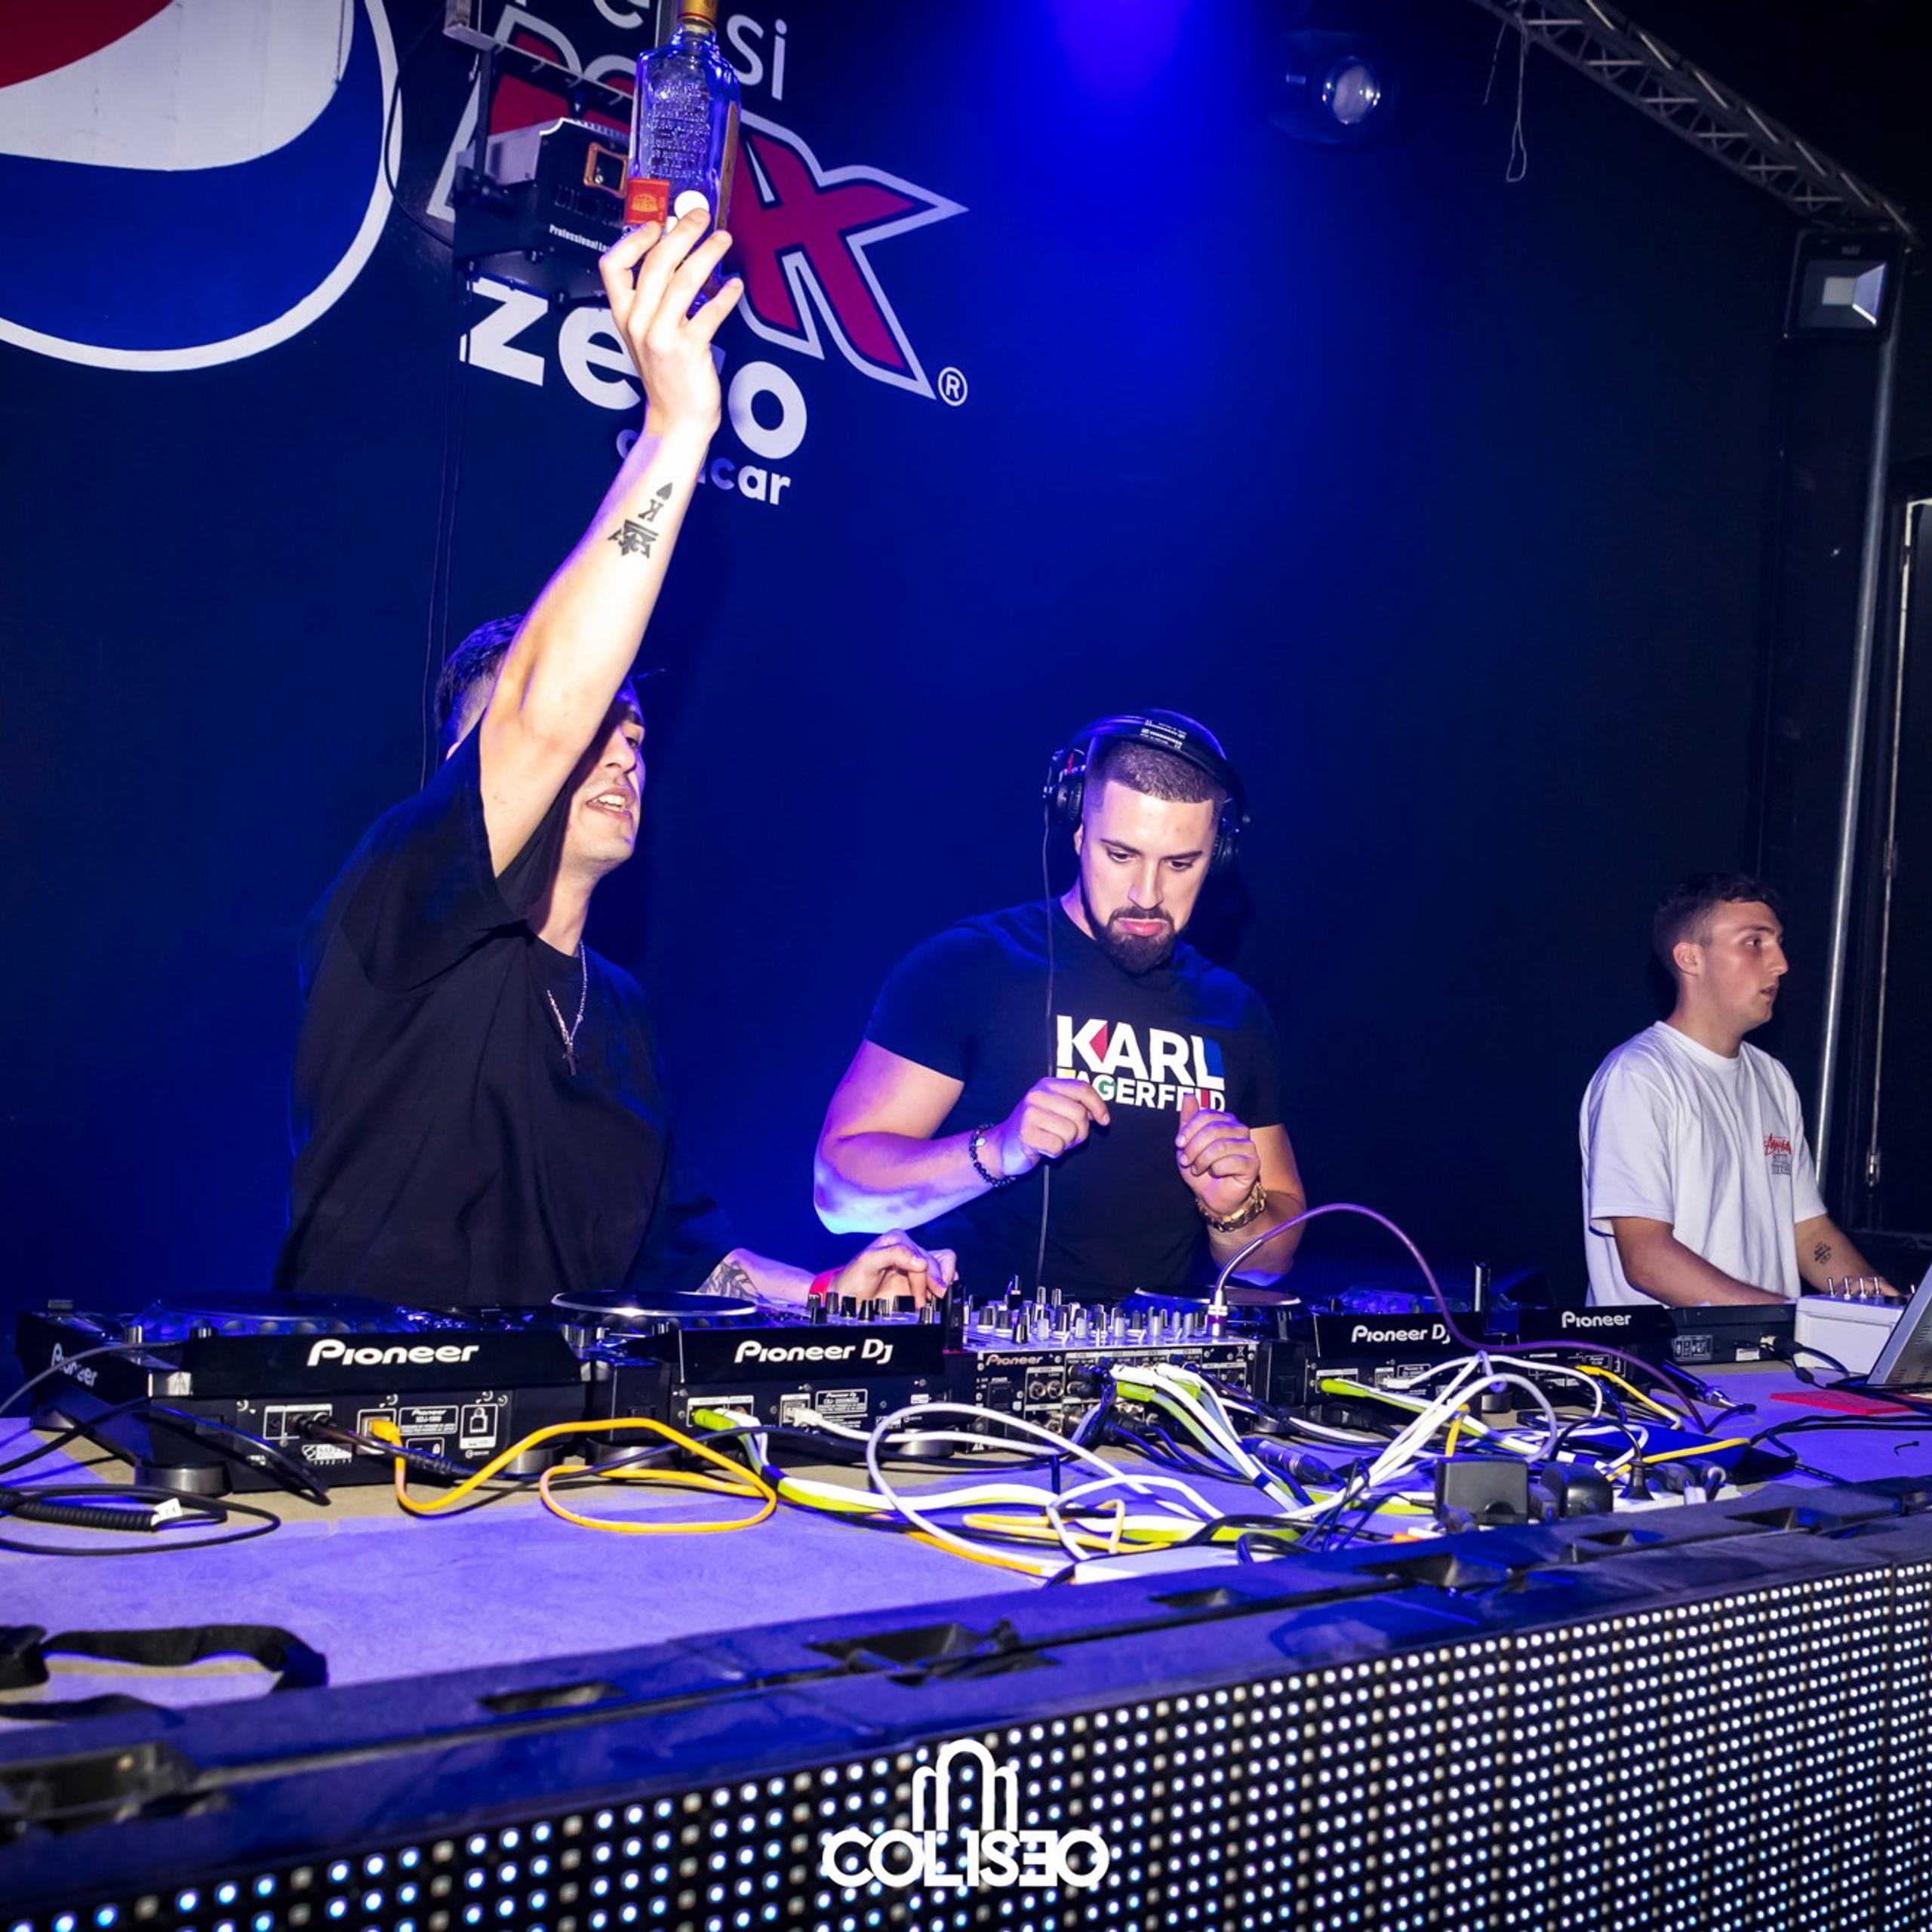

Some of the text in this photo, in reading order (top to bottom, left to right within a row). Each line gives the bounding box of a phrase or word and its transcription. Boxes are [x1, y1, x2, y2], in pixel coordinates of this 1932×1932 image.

[460, 277, 808, 460] zeo
[1057, 1014, 1226, 1091] KARL
[1561, 1311, 1632, 1329] Pioneer
[1351, 1324, 1429, 1343] Pioneer
[306, 1339, 480, 1367] Pioneer
[734, 1340, 857, 1364] Pioneer
[986, 1354, 1044, 1367] Pioneer
